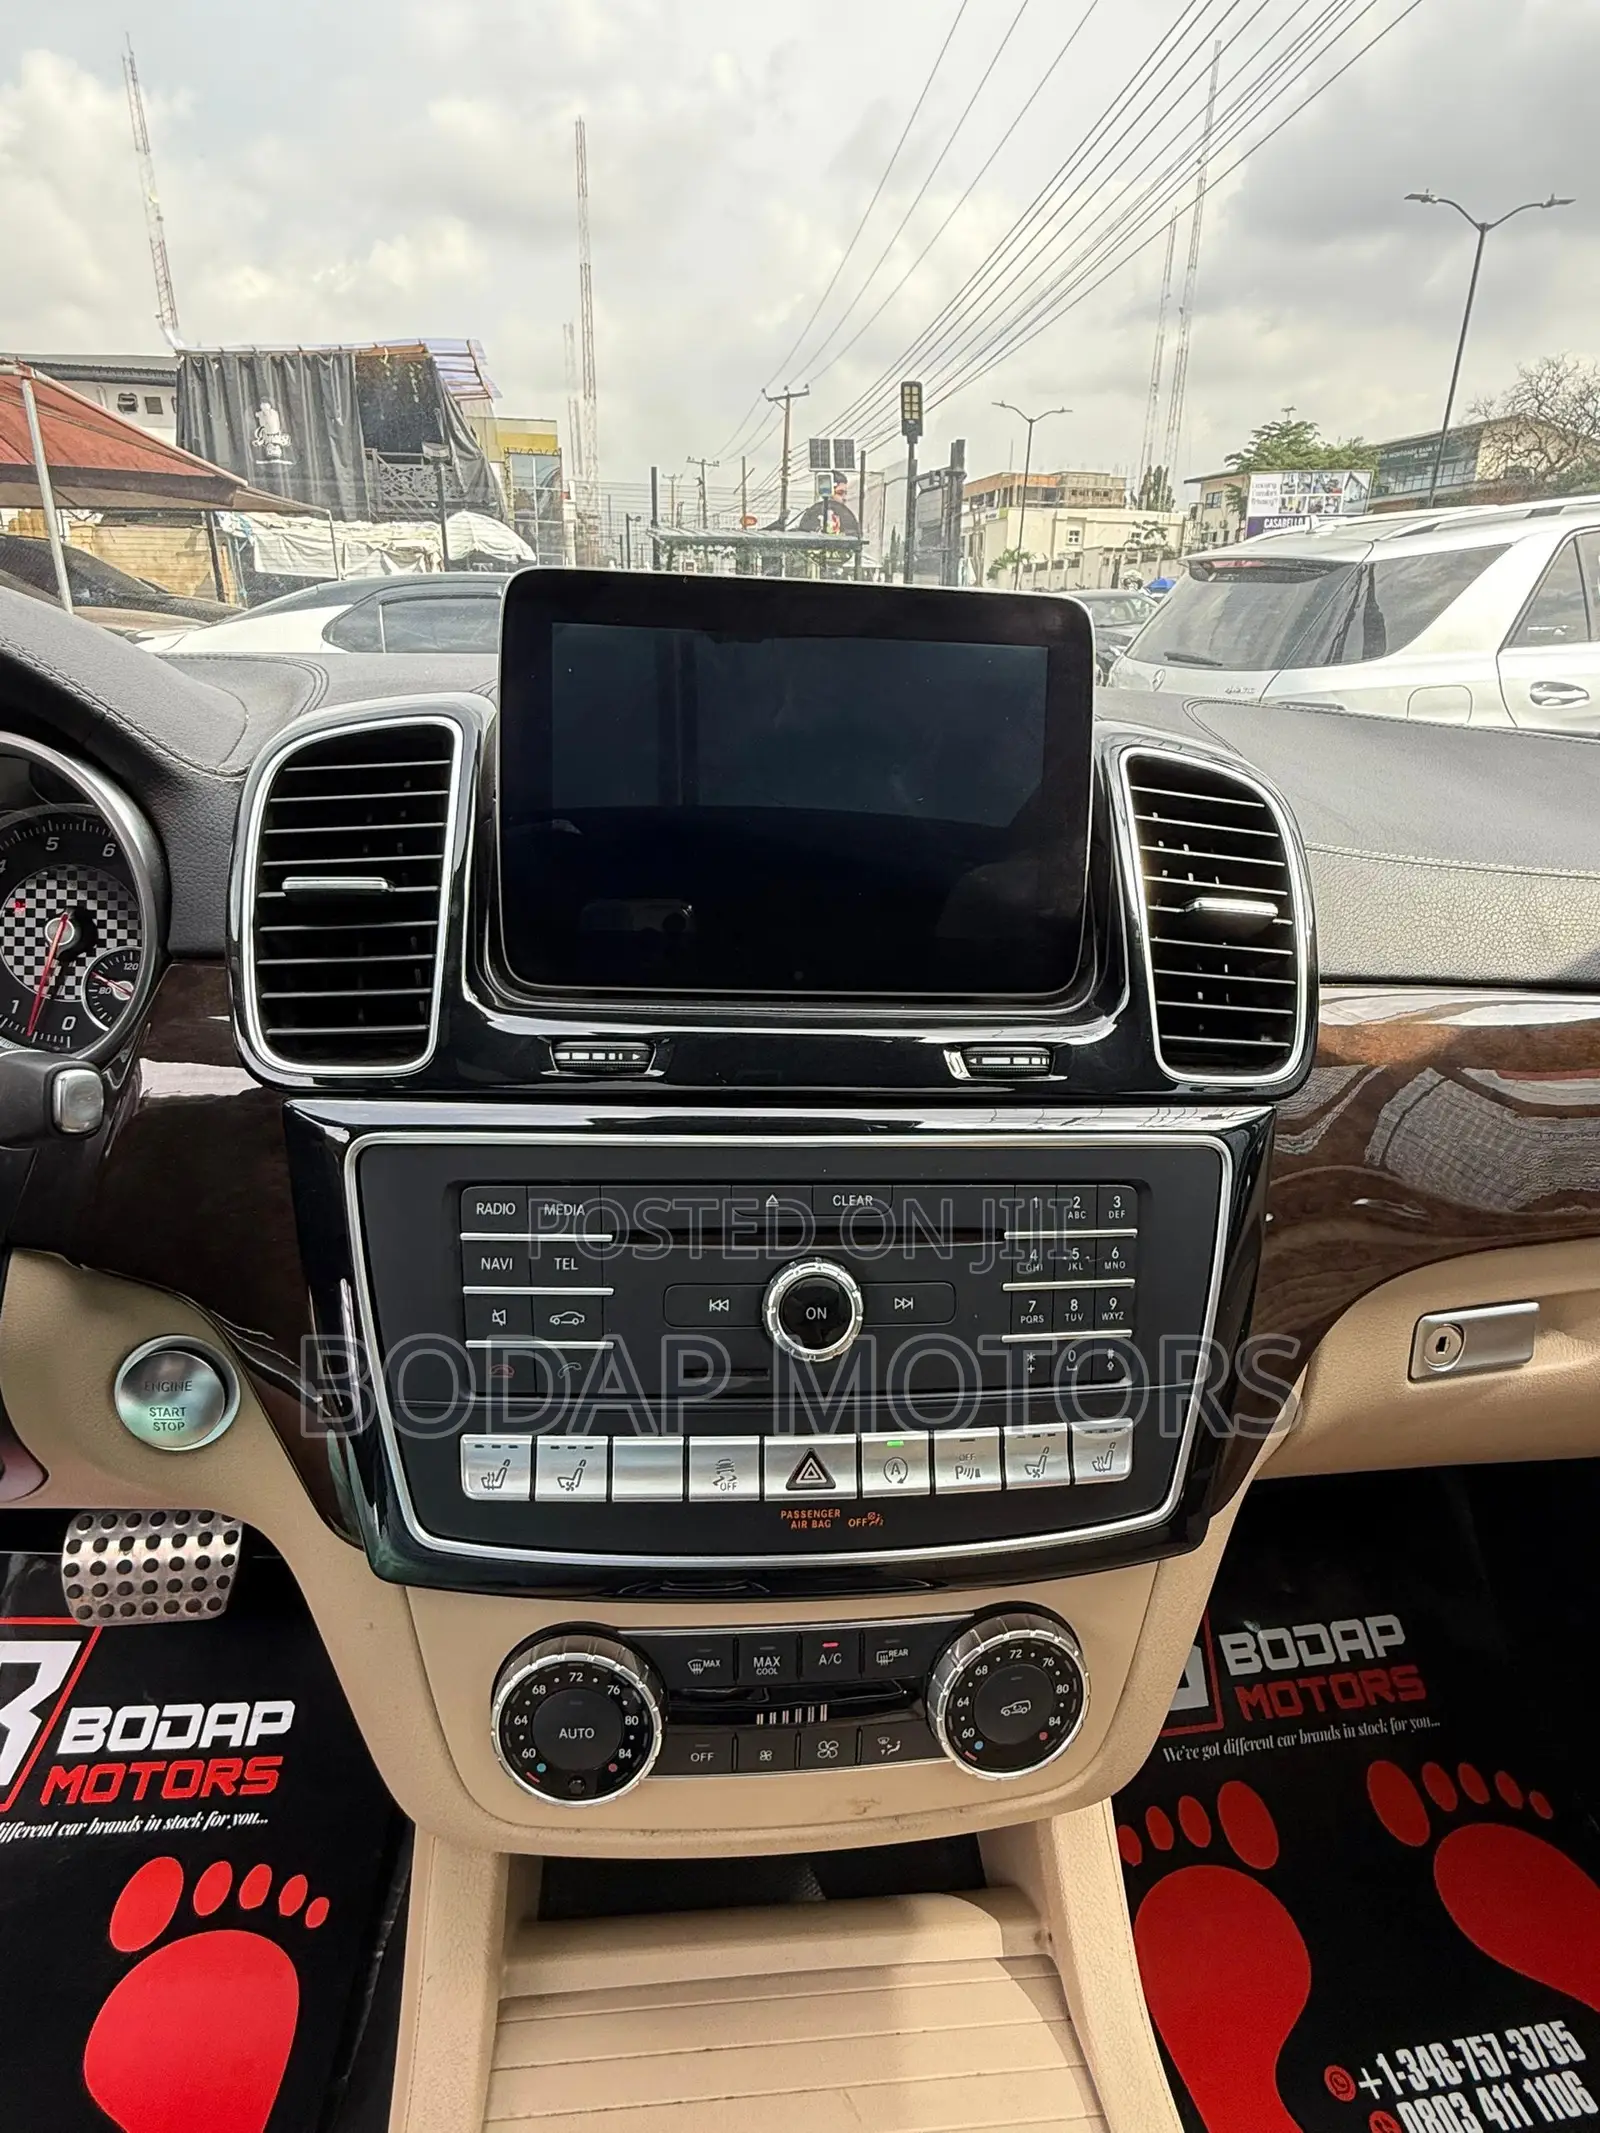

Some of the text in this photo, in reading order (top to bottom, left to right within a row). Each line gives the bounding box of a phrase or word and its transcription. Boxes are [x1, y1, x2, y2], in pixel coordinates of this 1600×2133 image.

[45, 837, 60, 851] 5
[102, 843, 117, 857] 6
[11, 1000, 20, 1014] 1
[832, 1194, 873, 1207] CLEAR
[1072, 1196, 1081, 1209] 2
[1113, 1196, 1122, 1209] 3
[476, 1202, 516, 1216] RADIO
[544, 1204, 585, 1217] MEDIA
[1108, 1209, 1126, 1219] DEF
[1067, 1210, 1087, 1220] ABC
[1071, 1247, 1080, 1260] 5
[1111, 1246, 1120, 1259] 6
[480, 1257, 513, 1271] NAVI
[554, 1257, 579, 1271] TEL
[1067, 1261, 1084, 1271] JKL
[1104, 1260, 1126, 1270] MNO
[1028, 1300, 1037, 1313] 7
[1070, 1299, 1078, 1312] 8
[1109, 1297, 1118, 1310] 9
[805, 1306, 828, 1321] ON
[1064, 1312, 1084, 1322] TUV
[1101, 1311, 1124, 1321] WXYZ
[144, 1380, 193, 1392] ENGINE
[149, 1406, 187, 1417] START
[153, 1421, 185, 1431] STOP
[719, 1481, 737, 1492] OFF
[780, 1509, 841, 1519] PASSENGER
[791, 1519, 832, 1529] AIR BAG
[848, 1518, 868, 1527] OFF
[1218, 1614, 1406, 1676] BODAP
[888, 1648, 908, 1657] REAR
[1009, 1649, 1022, 1659] 72
[703, 1659, 720, 1668] MAX
[753, 1656, 780, 1668] MAX
[818, 1653, 842, 1666] A/C
[1042, 1657, 1055, 1667] 76
[756, 1668, 778, 1676] COOL
[975, 1665, 988, 1676] 68
[569, 1672, 583, 1682] 72
[532, 1685, 546, 1695] 68
[607, 1685, 620, 1695] 76
[1056, 1684, 1069, 1694] 80
[1234, 1664, 1426, 1722] MOTORS
[957, 1697, 970, 1707] 64
[514, 1715, 528, 1725] 64
[625, 1715, 639, 1726] 80
[1048, 1716, 1061, 1726] 84
[57, 1700, 296, 1754] BODAP
[558, 1727, 595, 1740] AUTO
[962, 1728, 975, 1738] 60
[1162, 1717, 1441, 1763] We've got different car brands in stock for you...
[522, 1748, 536, 1758] 60
[618, 1748, 632, 1759] 84
[690, 1752, 714, 1763] OFF
[40, 1756, 283, 1806] MOTORS
[57, 1821, 88, 1837] car
[86, 1815, 143, 1835] brands
[144, 1814, 165, 1832] in
[163, 1811, 204, 1830] stock
[202, 1810, 231, 1831] for
[1358, 2020, 1587, 2100] +1-346-757-3795
[1475, 2081, 1535, 2132] 411
[1522, 2070, 1599, 2123] 1106
